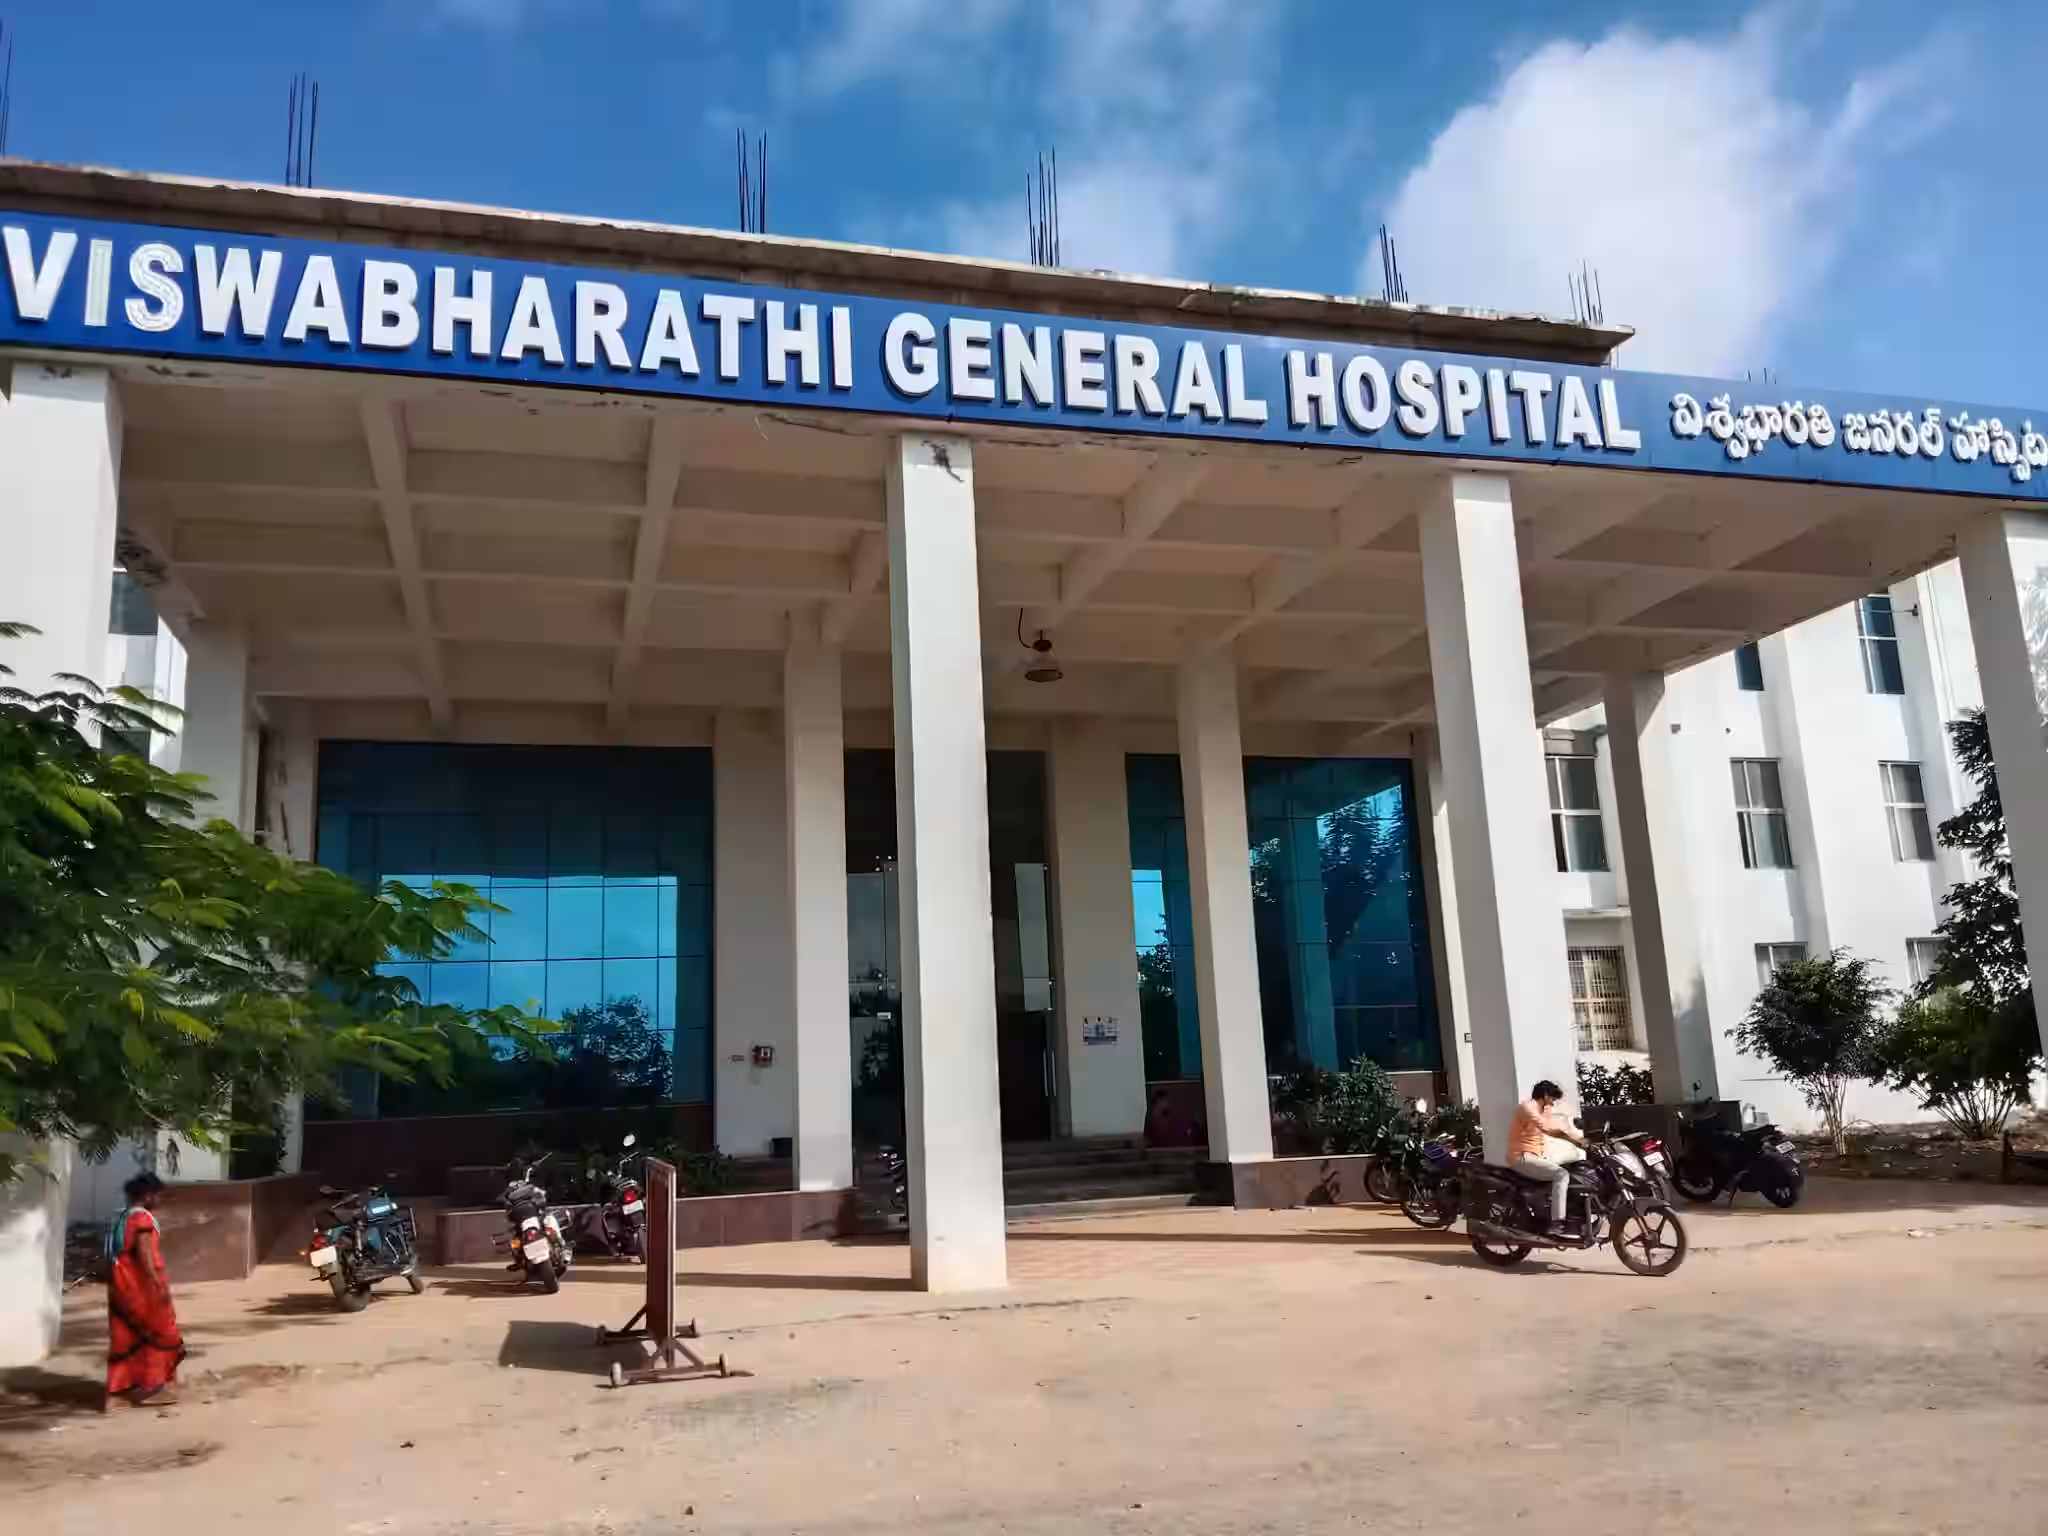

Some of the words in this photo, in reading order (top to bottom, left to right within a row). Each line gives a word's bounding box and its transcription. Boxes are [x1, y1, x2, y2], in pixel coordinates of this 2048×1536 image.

[3, 226, 853, 388] VISWABHARATHI
[884, 312, 1267, 423] GENERAL
[1286, 350, 1641, 451] HOSPITAL
[1671, 392, 1836, 459] విశ్వభారతి
[1842, 407, 1944, 458] జనరల్
